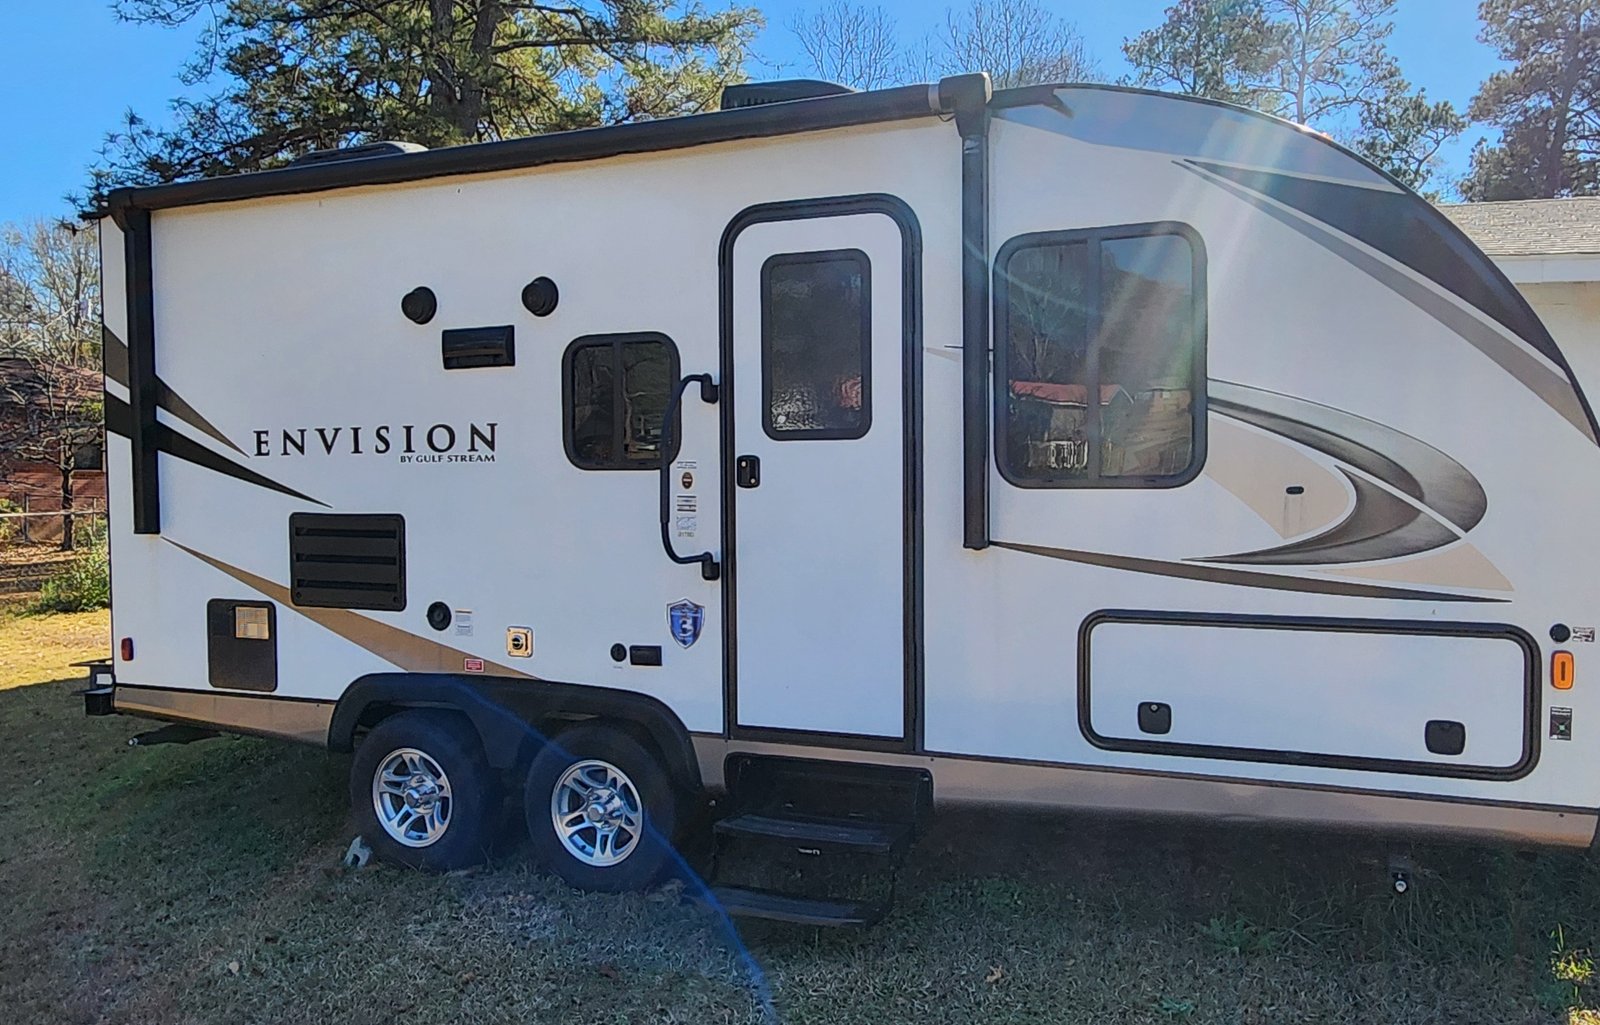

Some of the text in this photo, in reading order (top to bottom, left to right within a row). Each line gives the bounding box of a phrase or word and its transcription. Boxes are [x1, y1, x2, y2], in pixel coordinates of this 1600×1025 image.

[253, 422, 498, 456] ENVISION
[400, 454, 496, 463] BY GULF STREAM
